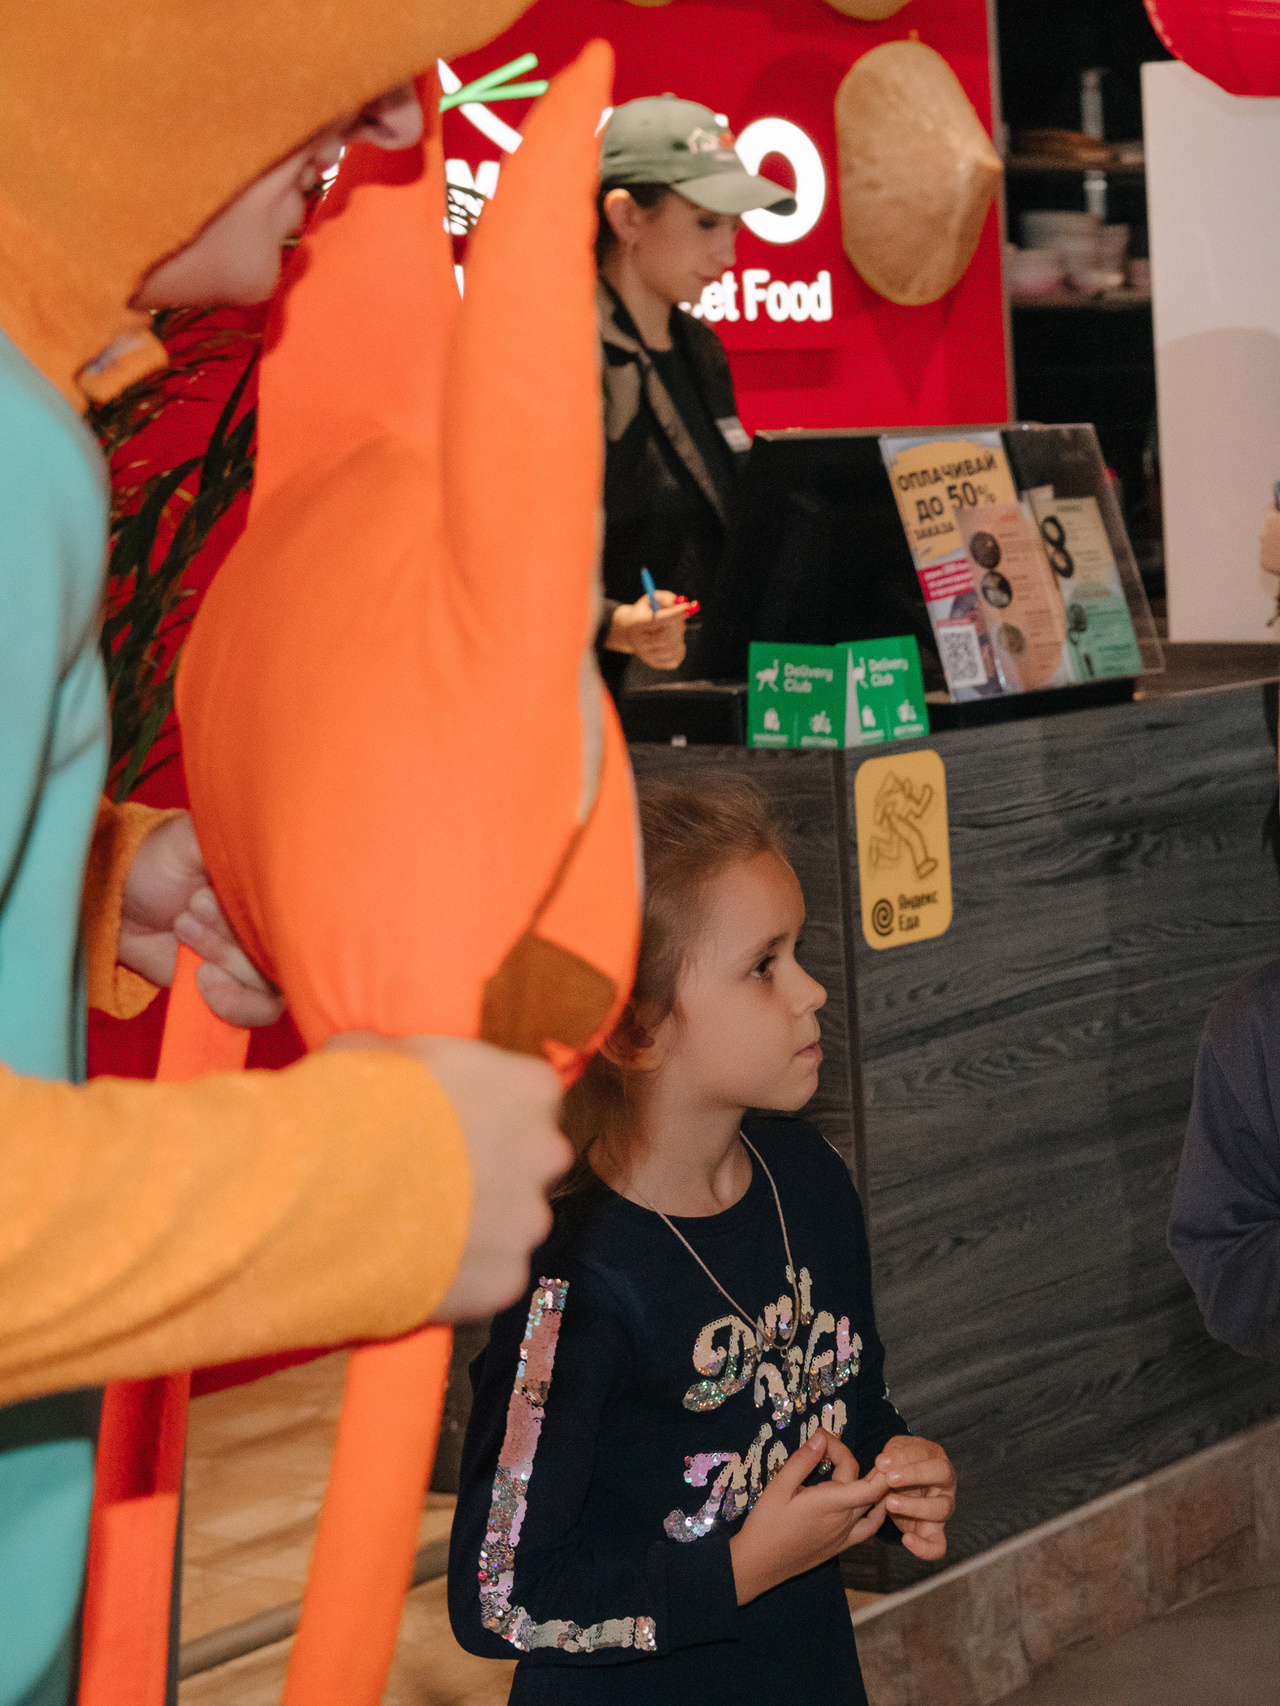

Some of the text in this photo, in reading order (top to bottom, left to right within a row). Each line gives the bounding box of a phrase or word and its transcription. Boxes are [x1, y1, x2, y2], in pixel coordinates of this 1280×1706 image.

[742, 269, 833, 322] Food
[897, 451, 997, 491] ОПЛАЧИВАЙ
[916, 481, 996, 523] ДО 50%
[783, 662, 834, 683] Delivery
[867, 657, 909, 673] Delivery
[783, 677, 812, 693] Club
[870, 672, 894, 687] Club
